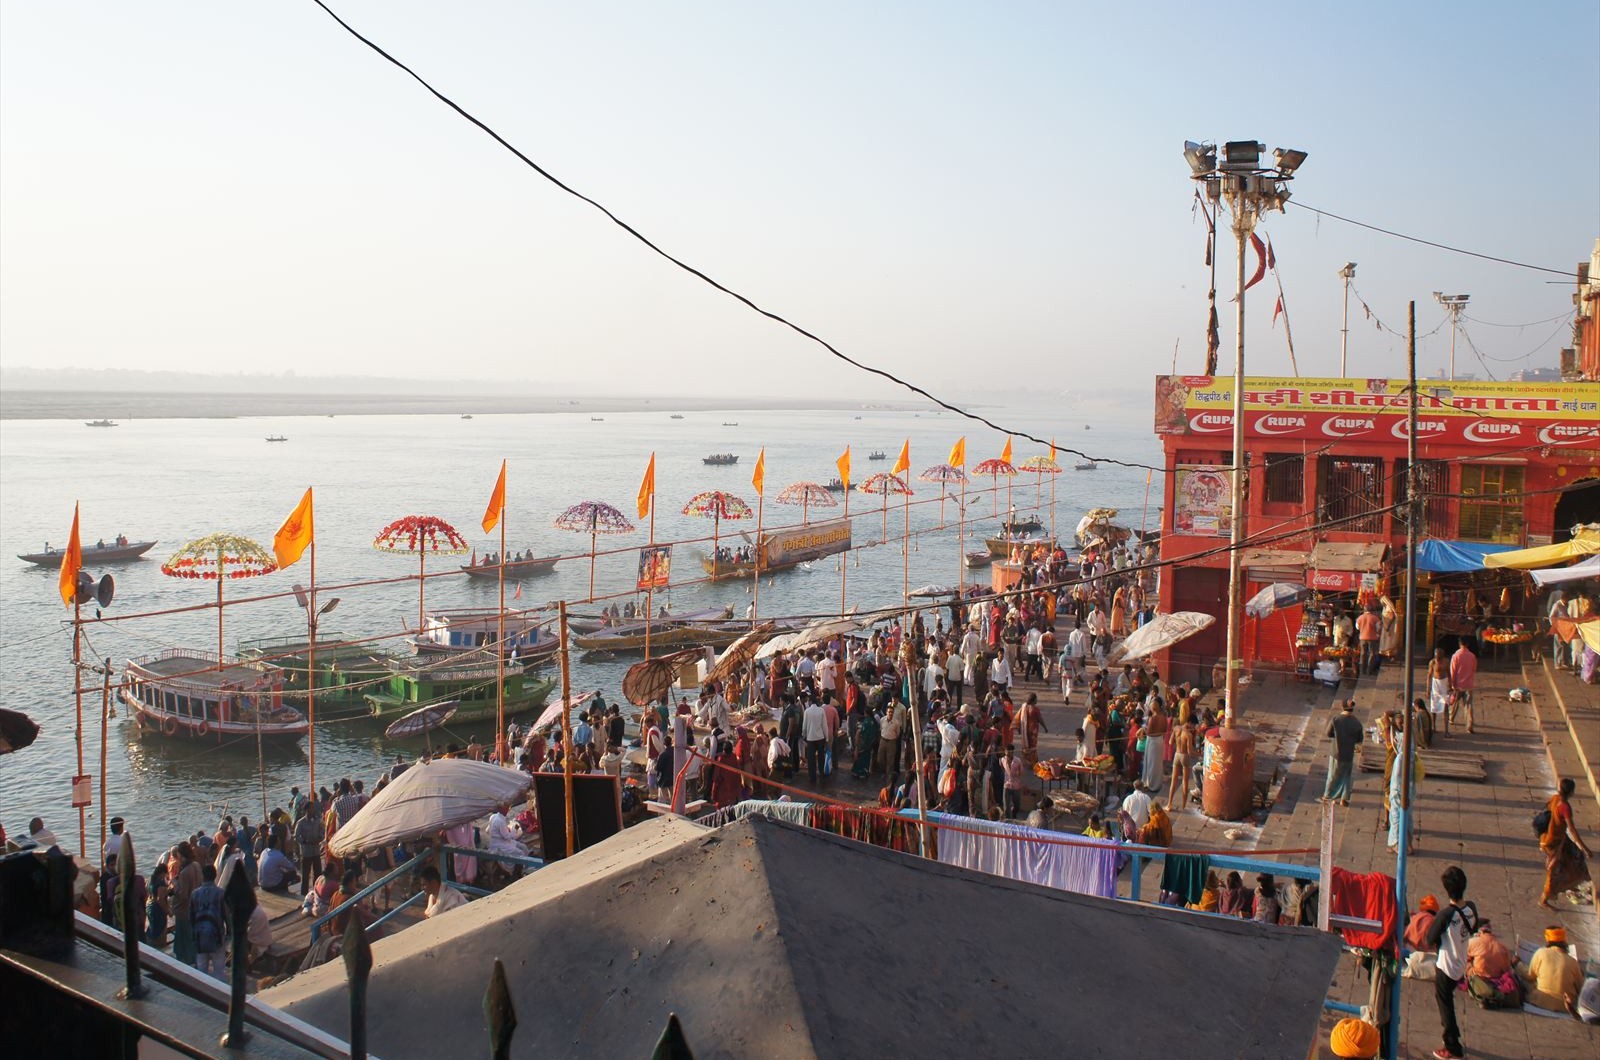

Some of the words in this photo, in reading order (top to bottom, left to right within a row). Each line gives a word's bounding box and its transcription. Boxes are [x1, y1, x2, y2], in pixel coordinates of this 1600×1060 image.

[1452, 396, 1560, 411] माता
[1267, 417, 1306, 427] RUPA
[1335, 418, 1375, 429] RUPA
[1478, 423, 1521, 434] RUPA
[1554, 425, 1600, 437] RUPA
